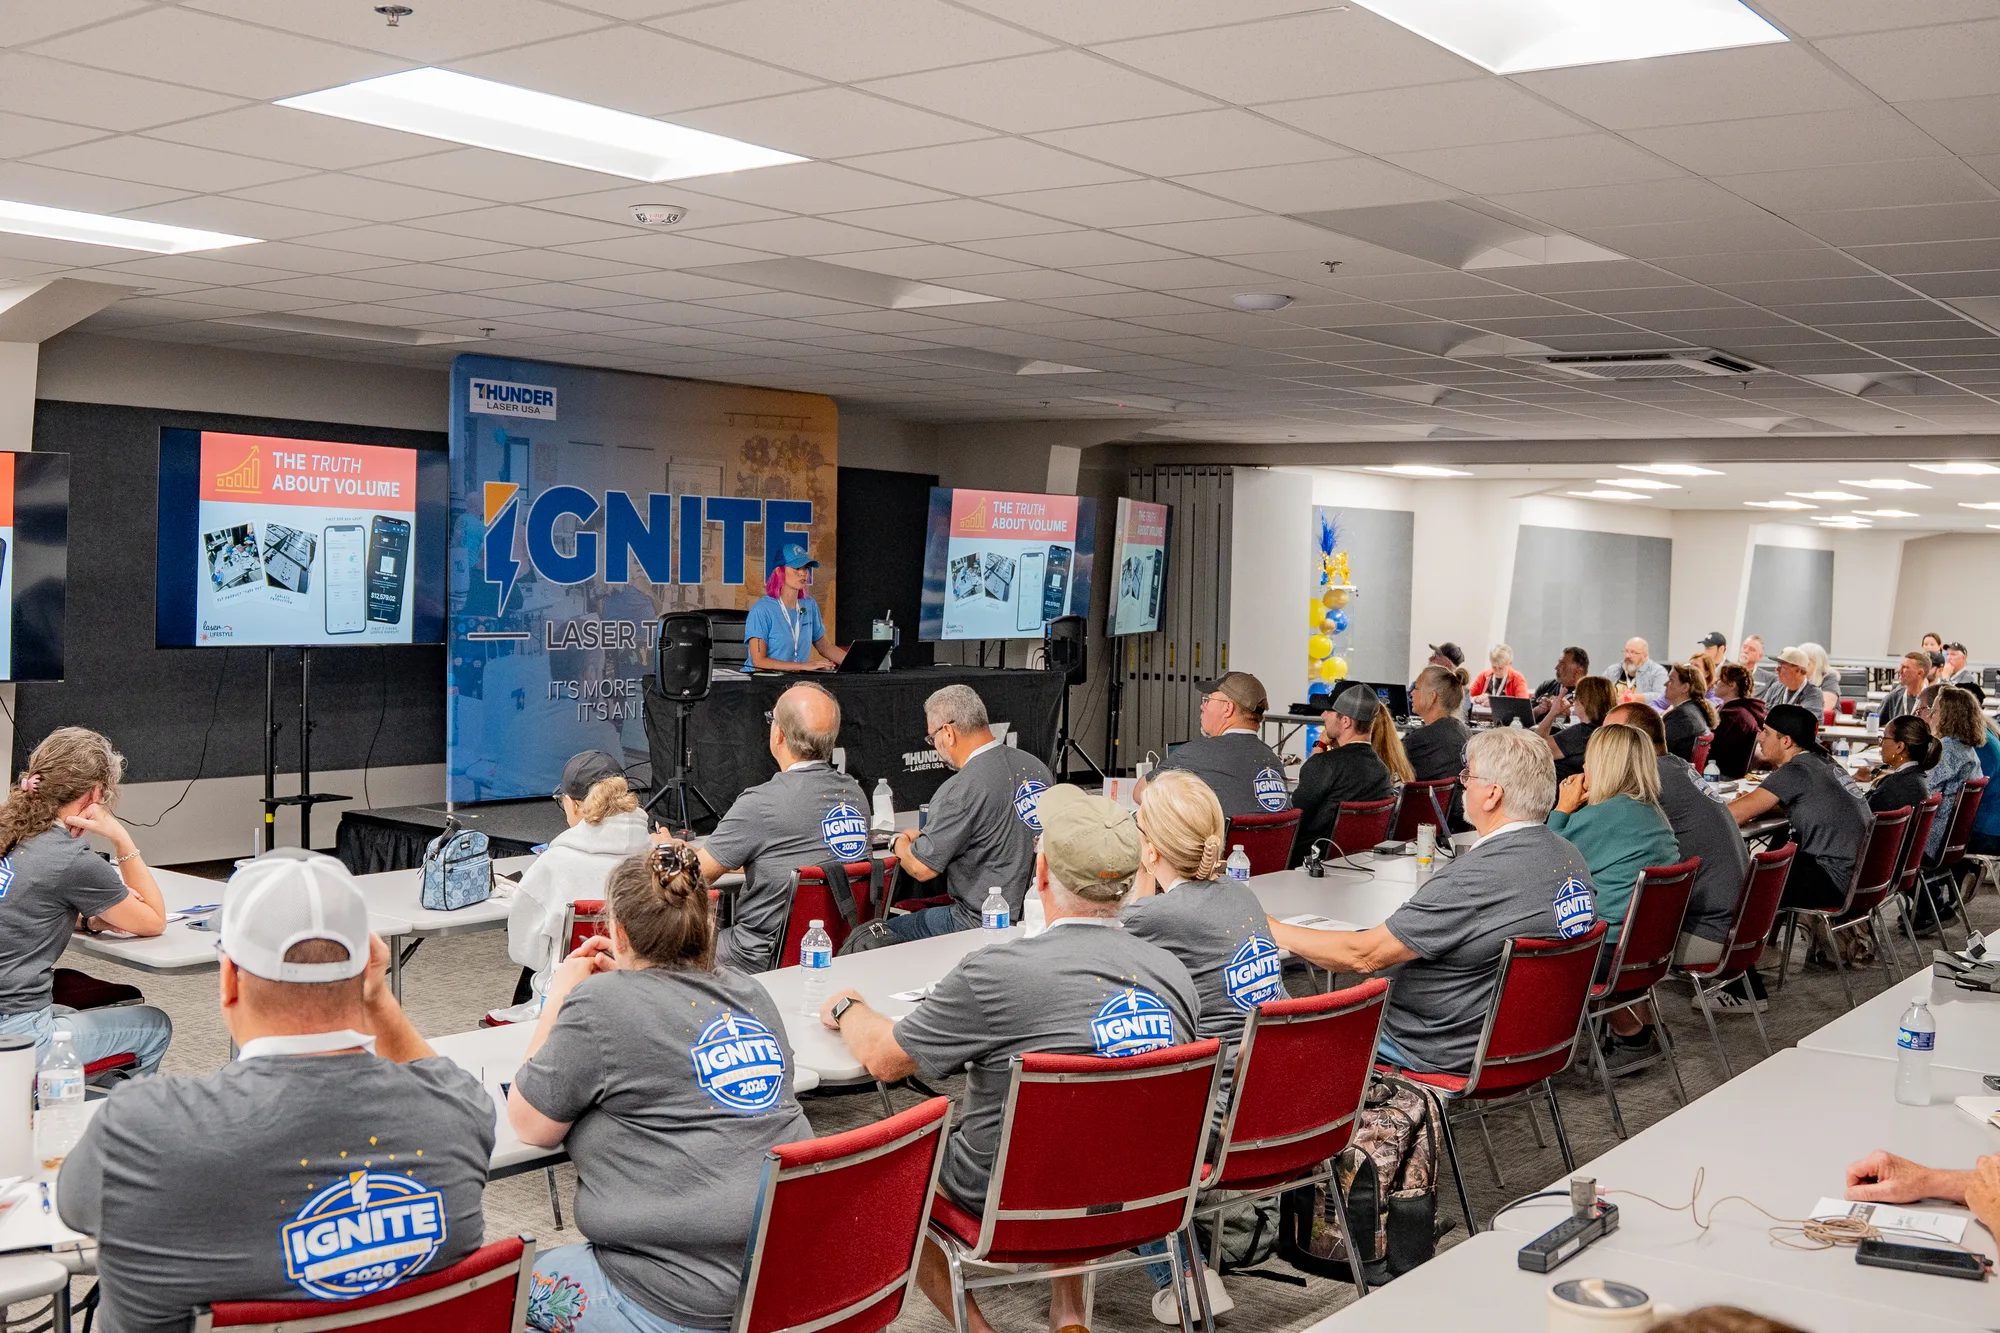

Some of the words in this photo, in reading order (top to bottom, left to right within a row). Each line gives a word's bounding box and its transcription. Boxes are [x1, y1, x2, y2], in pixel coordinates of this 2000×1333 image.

[473, 382, 553, 406] THUNDER
[487, 401, 519, 412] LASER
[521, 405, 540, 414] USA
[272, 452, 306, 470] THE
[311, 454, 362, 474] TRUTH
[271, 474, 330, 494] ABOUT
[334, 478, 400, 498] VOLUME
[993, 501, 1013, 514] THE
[1015, 502, 1046, 516] TRUTH
[991, 517, 1026, 531] ABOUT
[1028, 519, 1067, 532] VOLUME
[484, 481, 813, 617] IGNITE
[202, 620, 222, 631] laser
[545, 620, 636, 650] LASER
[548, 680, 580, 700] IT'S
[583, 678, 636, 699] MORE
[577, 702, 608, 722] IT'S
[611, 701, 637, 720] AN
[910, 763, 931, 772] LASER
[932, 762, 944, 770] USA
[824, 819, 866, 836] IGNITE
[842, 842, 857, 850] 2026
[1556, 895, 1592, 920] IGNITE
[1229, 953, 1280, 988] IGNITE
[1251, 987, 1272, 1002] 2026
[1097, 1014, 1170, 1045] IGNITE
[698, 1039, 782, 1076] IGNITE
[738, 1078, 768, 1096] 2026
[291, 1201, 438, 1264] IGNITE
[311, 1257, 358, 1277] LASER
[360, 1242, 427, 1262] TRAINING
[344, 1262, 397, 1285] 2026
